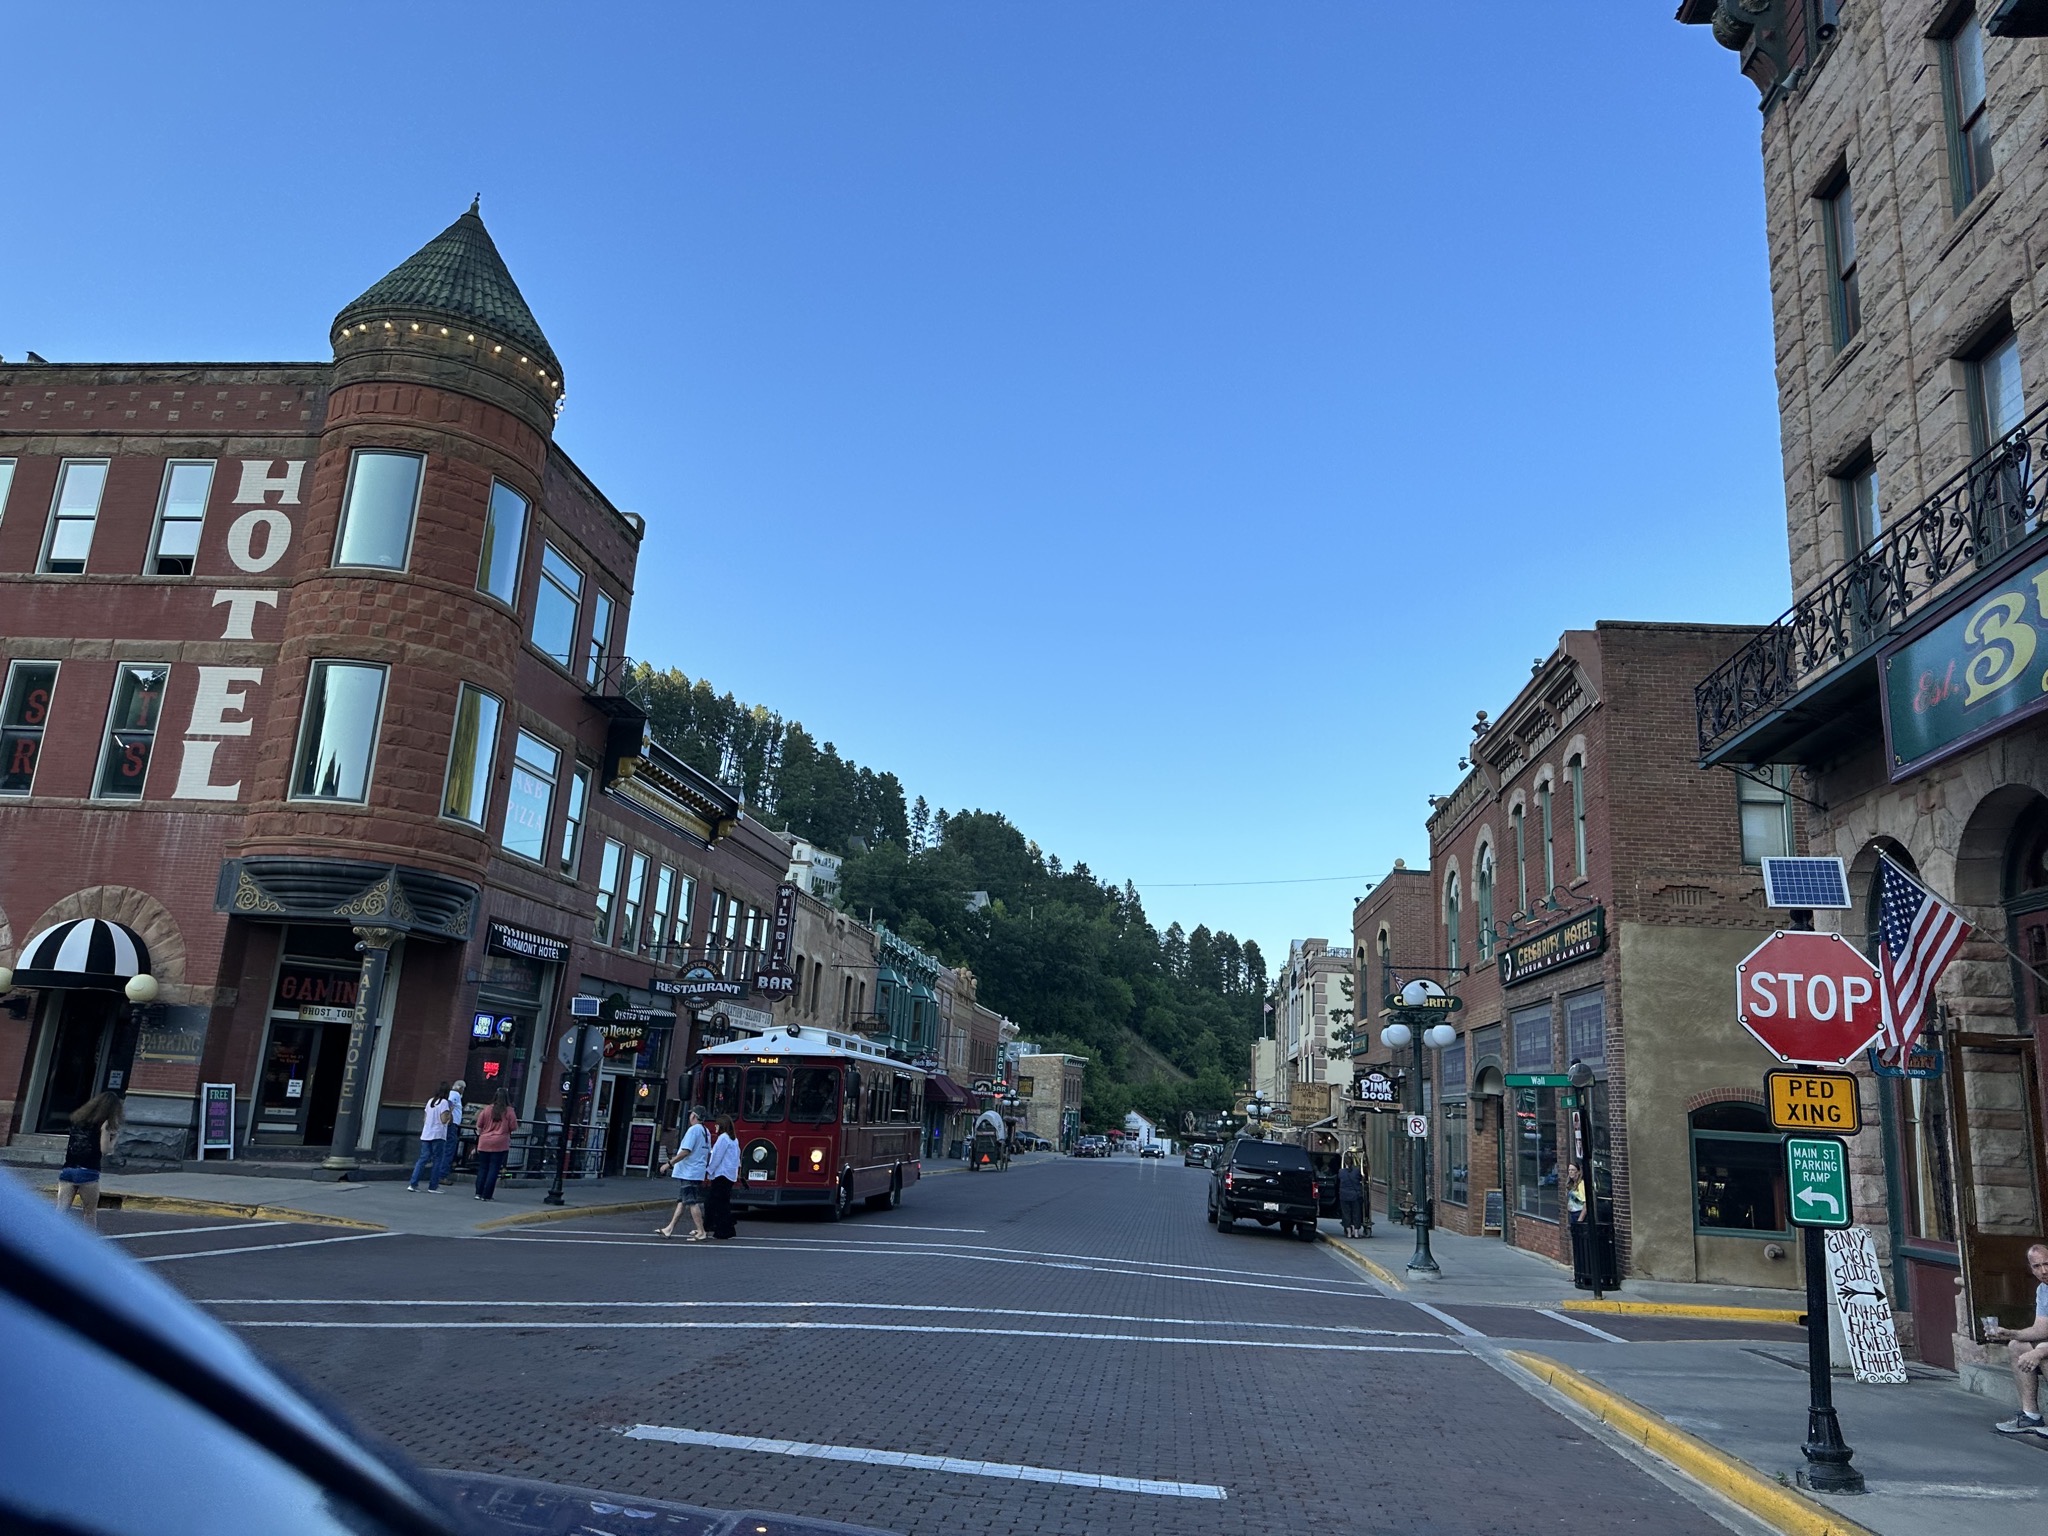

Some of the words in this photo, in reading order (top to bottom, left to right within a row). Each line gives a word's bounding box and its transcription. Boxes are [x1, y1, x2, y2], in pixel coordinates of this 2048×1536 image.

[171, 460, 306, 800] HOTEL
[777, 887, 793, 928] WILD
[502, 935, 537, 956] FAIRMONT
[538, 945, 560, 960] HOTEL
[772, 931, 786, 971] BILL
[1517, 932, 1560, 967] CELEBRITY
[1564, 918, 1593, 948] HOTEL
[682, 960, 707, 975] OYSTER
[707, 963, 720, 976] BAY
[1515, 961, 1543, 978] MUSEUM
[1556, 941, 1591, 962] GAMING
[655, 981, 741, 996] RESTAURANT
[757, 975, 793, 991] BAR
[684, 1000, 710, 1010] GAMING
[1750, 971, 1873, 1023] STOP
[302, 1006, 331, 1017] GHOST
[142, 1031, 200, 1052] PARKING
[619, 1040, 638, 1050] PUB
[338, 1032, 363, 1115] HOTEL
[1531, 1076, 1546, 1085] Wall
[210, 1090, 228, 1100] FREE
[992, 1085, 1007, 1093] BAR
[1360, 1079, 1393, 1094] PINK
[1361, 1092, 1393, 1101] DOOR
[1789, 1079, 1834, 1099] PED
[1788, 1103, 1841, 1124] XING
[1793, 1147, 1818, 1159] MAIN
[1795, 1159, 1838, 1172] PARKING
[1803, 1171, 1831, 1183] RAMP
[1828, 1231, 1865, 1254] GINNY
[1840, 1249, 1875, 1269] WOLF
[1834, 1263, 1880, 1287] STUDIO
[1848, 1330, 1899, 1352] JEWELRY
